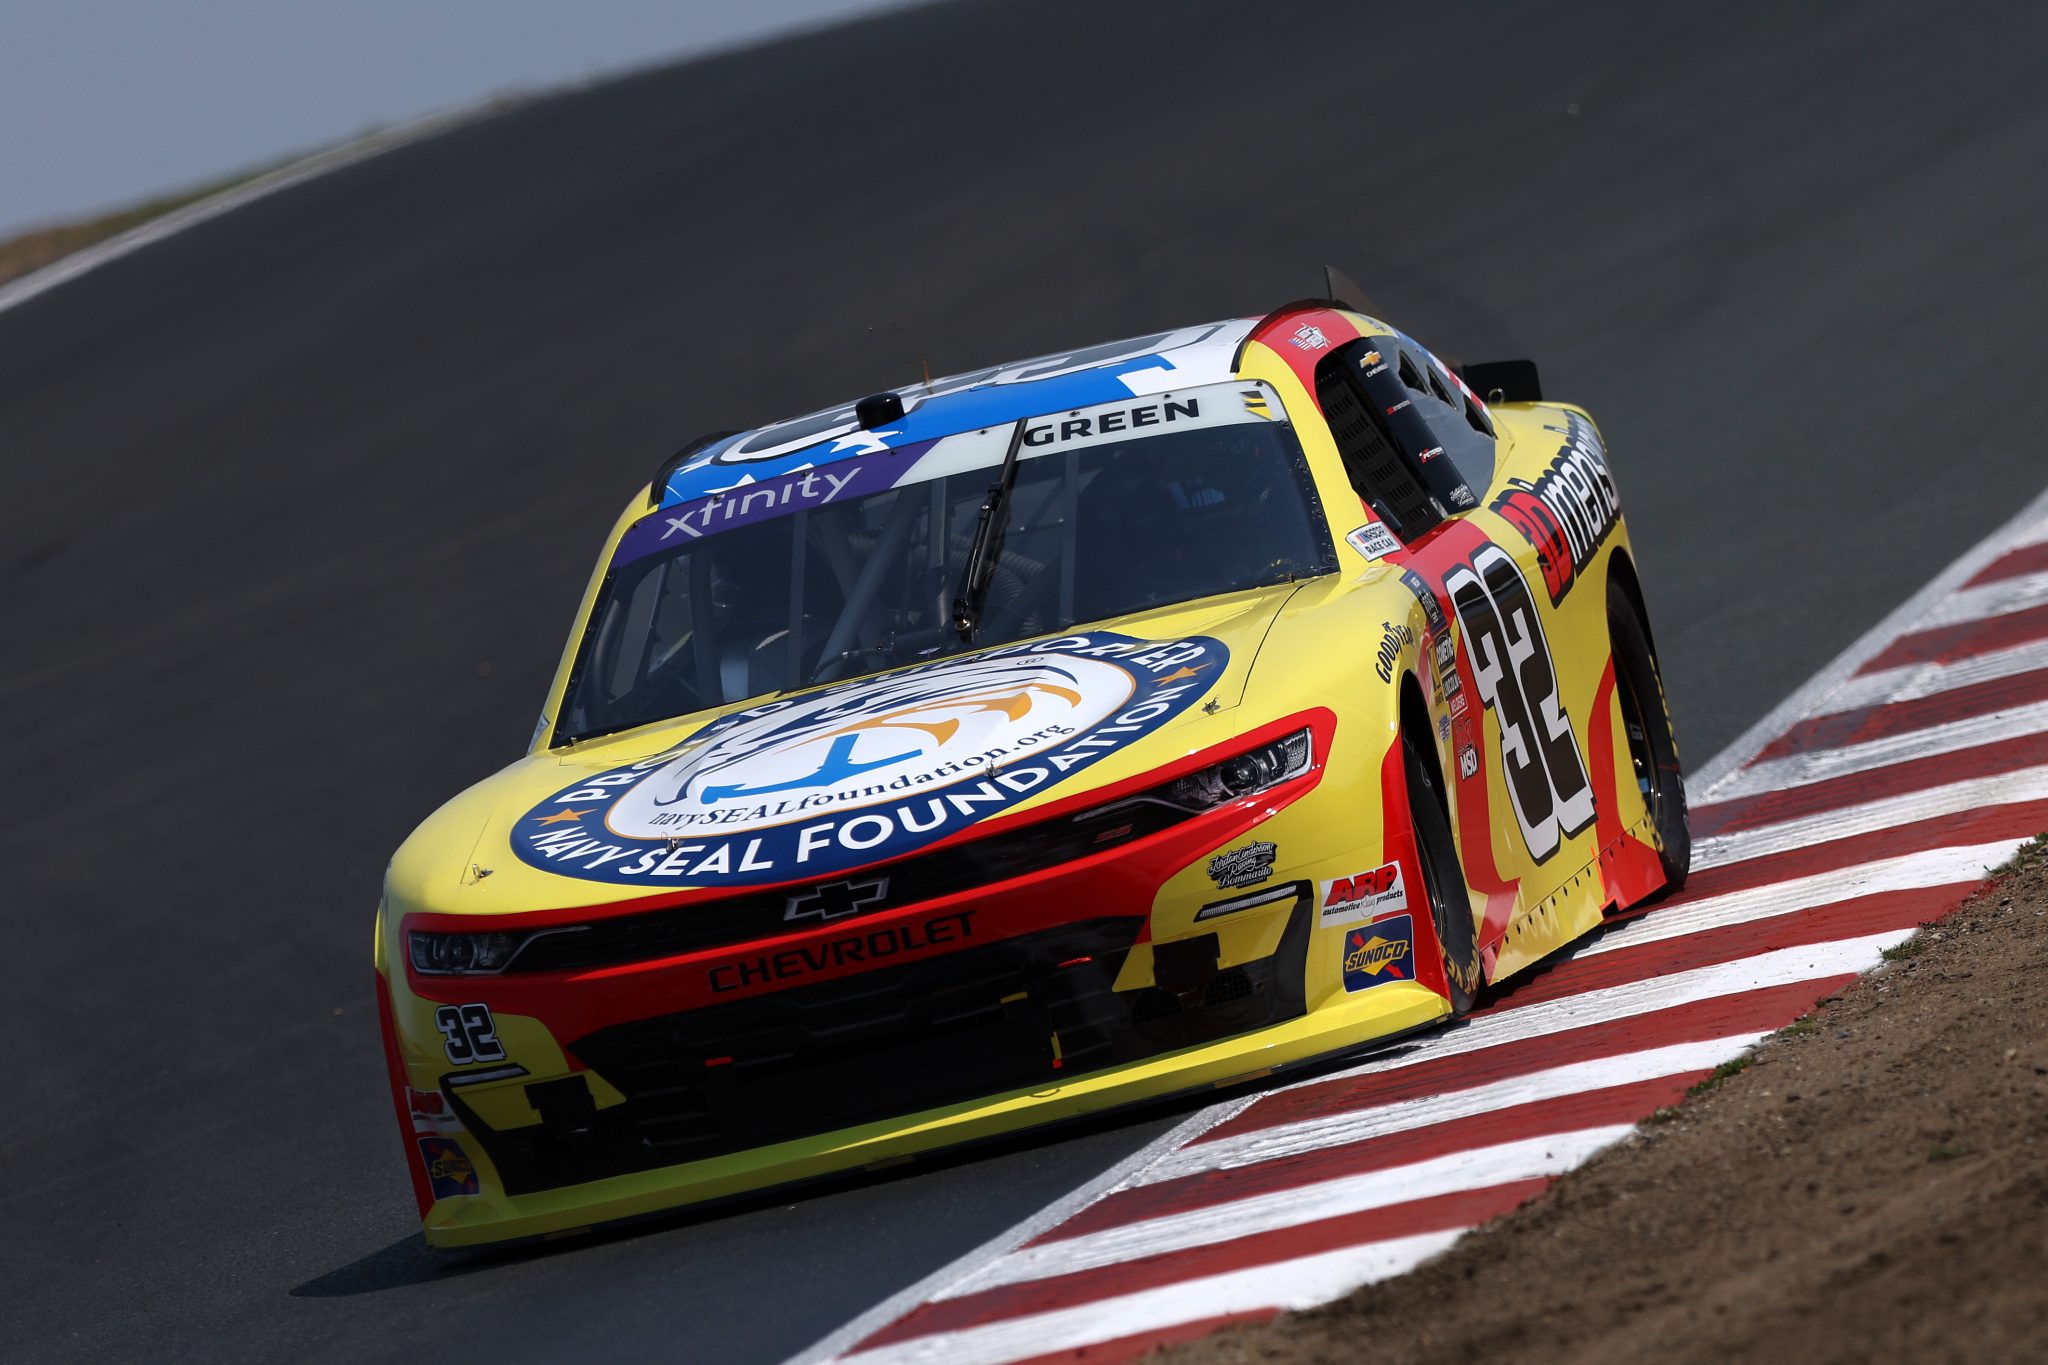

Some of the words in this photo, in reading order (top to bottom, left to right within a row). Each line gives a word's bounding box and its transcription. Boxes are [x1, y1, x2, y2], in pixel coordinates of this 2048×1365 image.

[1023, 398, 1200, 447] GREEN
[659, 467, 862, 541] xfinity
[1365, 541, 1384, 555] RACE
[1441, 541, 1599, 866] 32
[530, 826, 639, 869] NAVY
[619, 842, 773, 876] SEAL
[797, 682, 1199, 863] FOUNDATION
[648, 724, 1075, 829] navySEALfoundation.org
[1459, 748, 1477, 780] MSD
[1217, 866, 1272, 889] Bommarito
[1324, 864, 1398, 907] ARP
[1322, 902, 1361, 916] automotive
[1376, 889, 1404, 906] products
[708, 910, 977, 993] CHEVROLET
[1346, 940, 1406, 970] SUNOCO
[434, 1003, 507, 1065] 32
